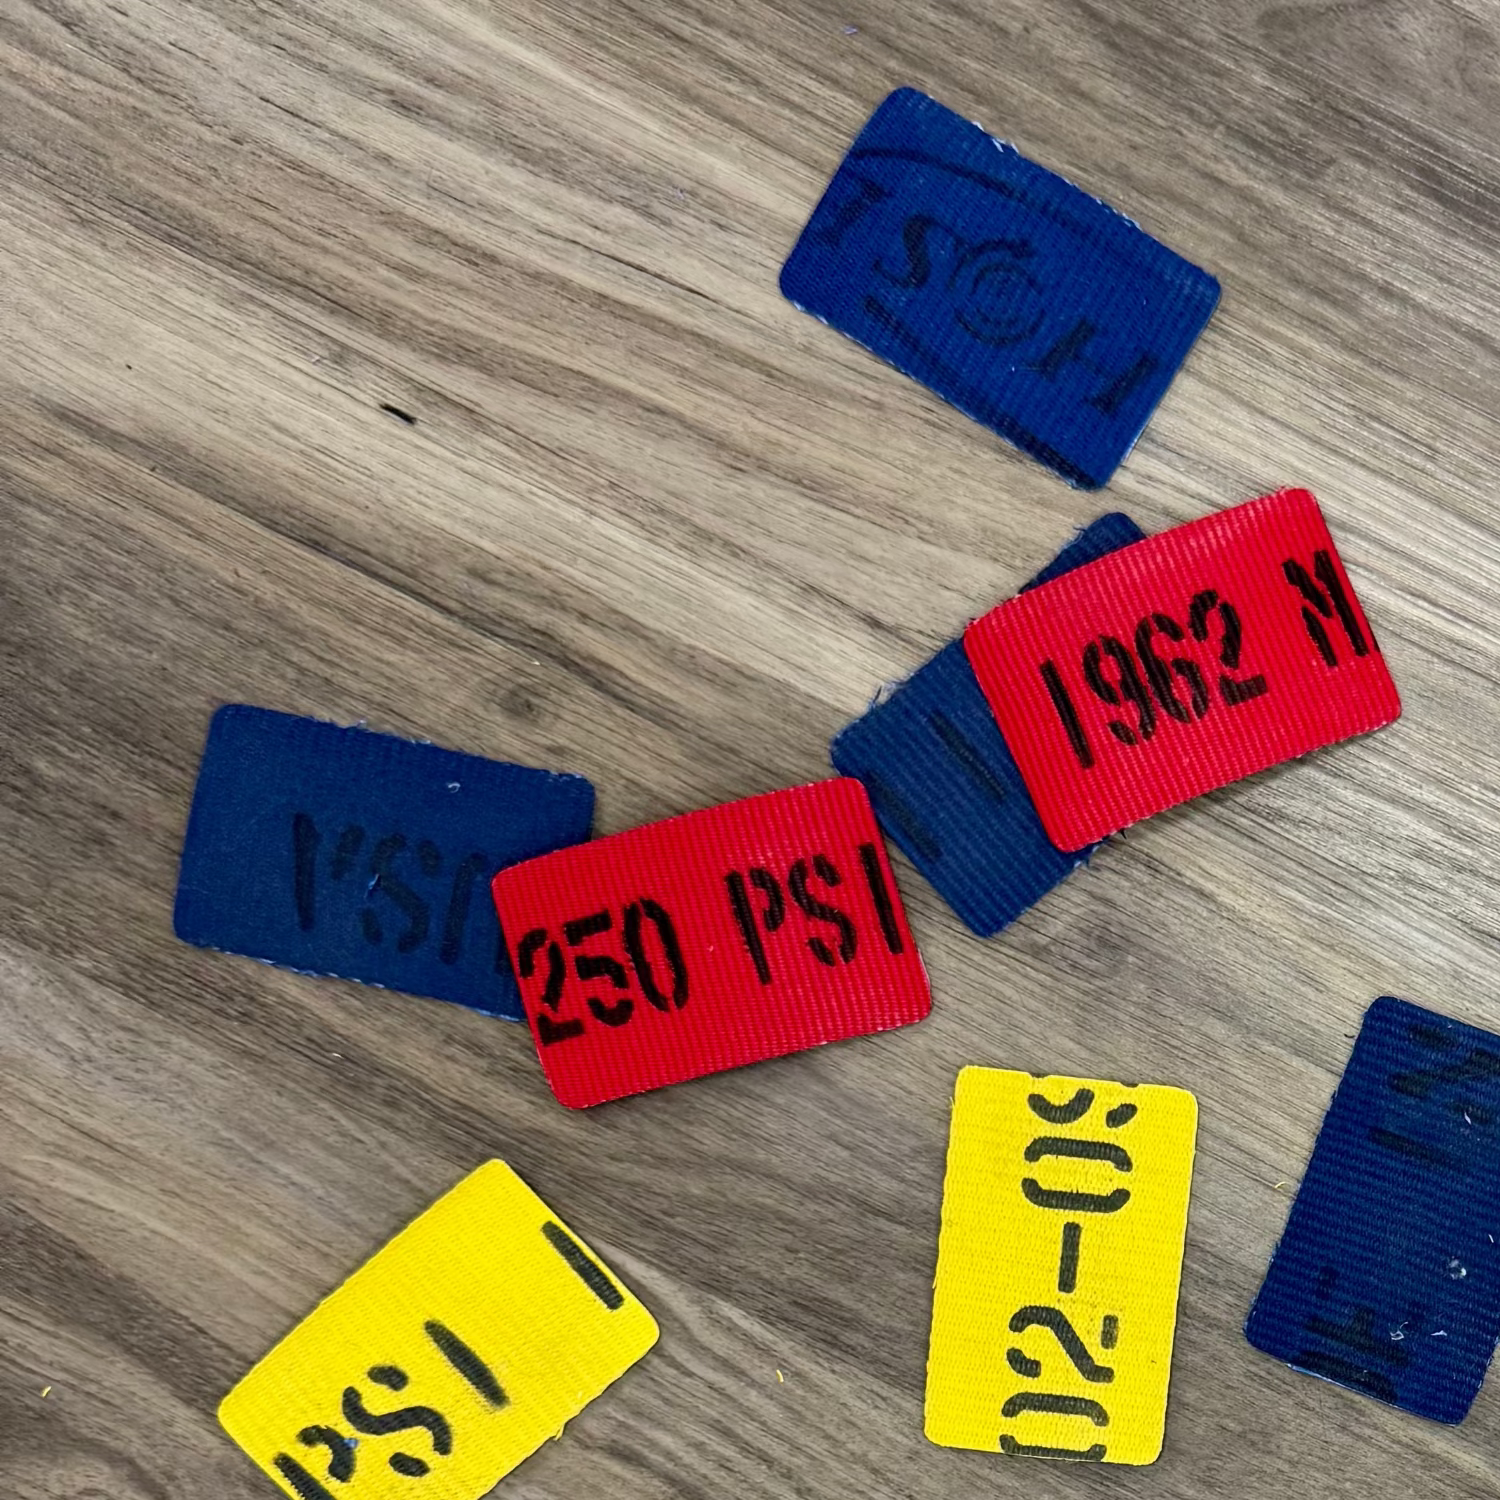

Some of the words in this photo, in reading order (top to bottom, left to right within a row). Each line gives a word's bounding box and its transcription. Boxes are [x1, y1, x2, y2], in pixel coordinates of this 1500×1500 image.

[1039, 590, 1269, 769] 1962
[518, 897, 689, 1047] 250
[725, 842, 904, 986] PSI
